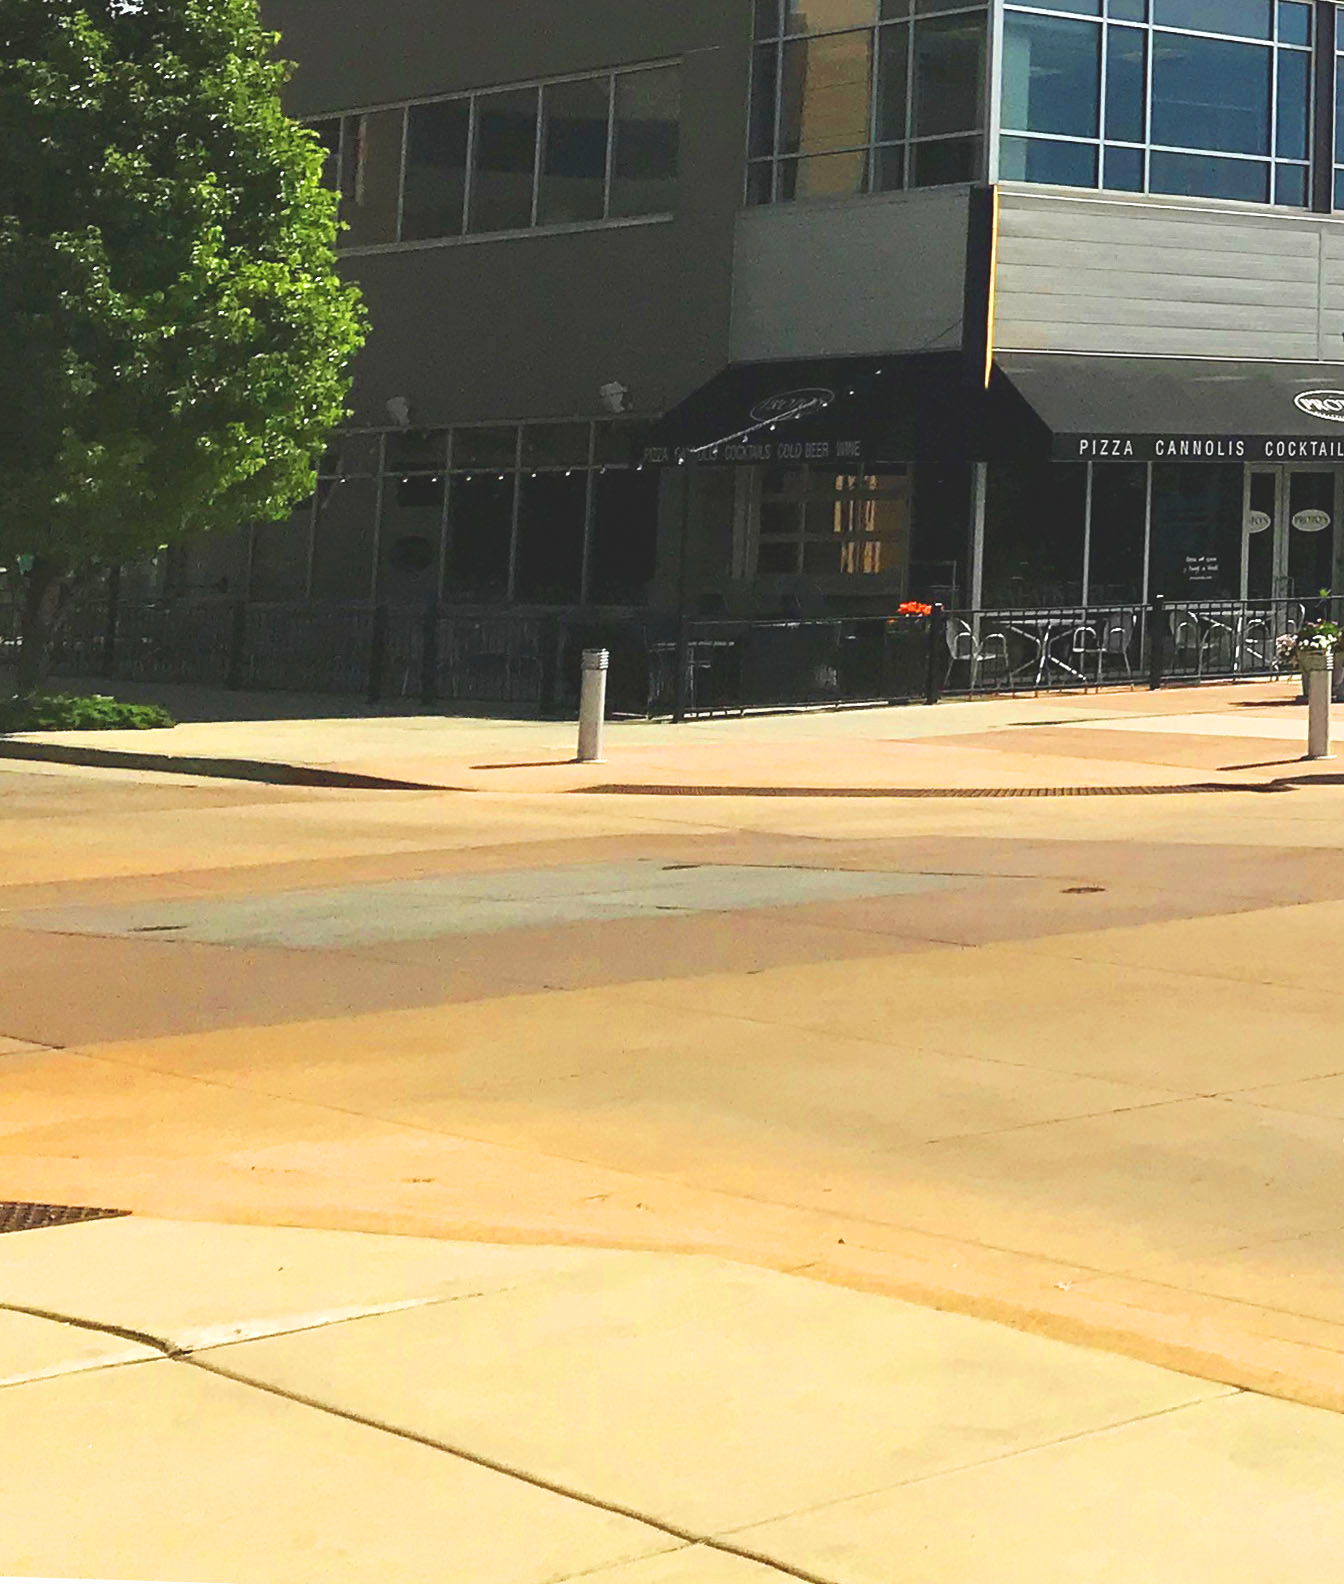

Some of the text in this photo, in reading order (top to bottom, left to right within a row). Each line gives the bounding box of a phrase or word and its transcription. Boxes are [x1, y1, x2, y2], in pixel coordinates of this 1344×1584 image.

[777, 444, 801, 459] COLD
[804, 442, 829, 458] BEER
[1079, 439, 1133, 456] PIZZA
[1155, 440, 1245, 457] CANNOLIS
